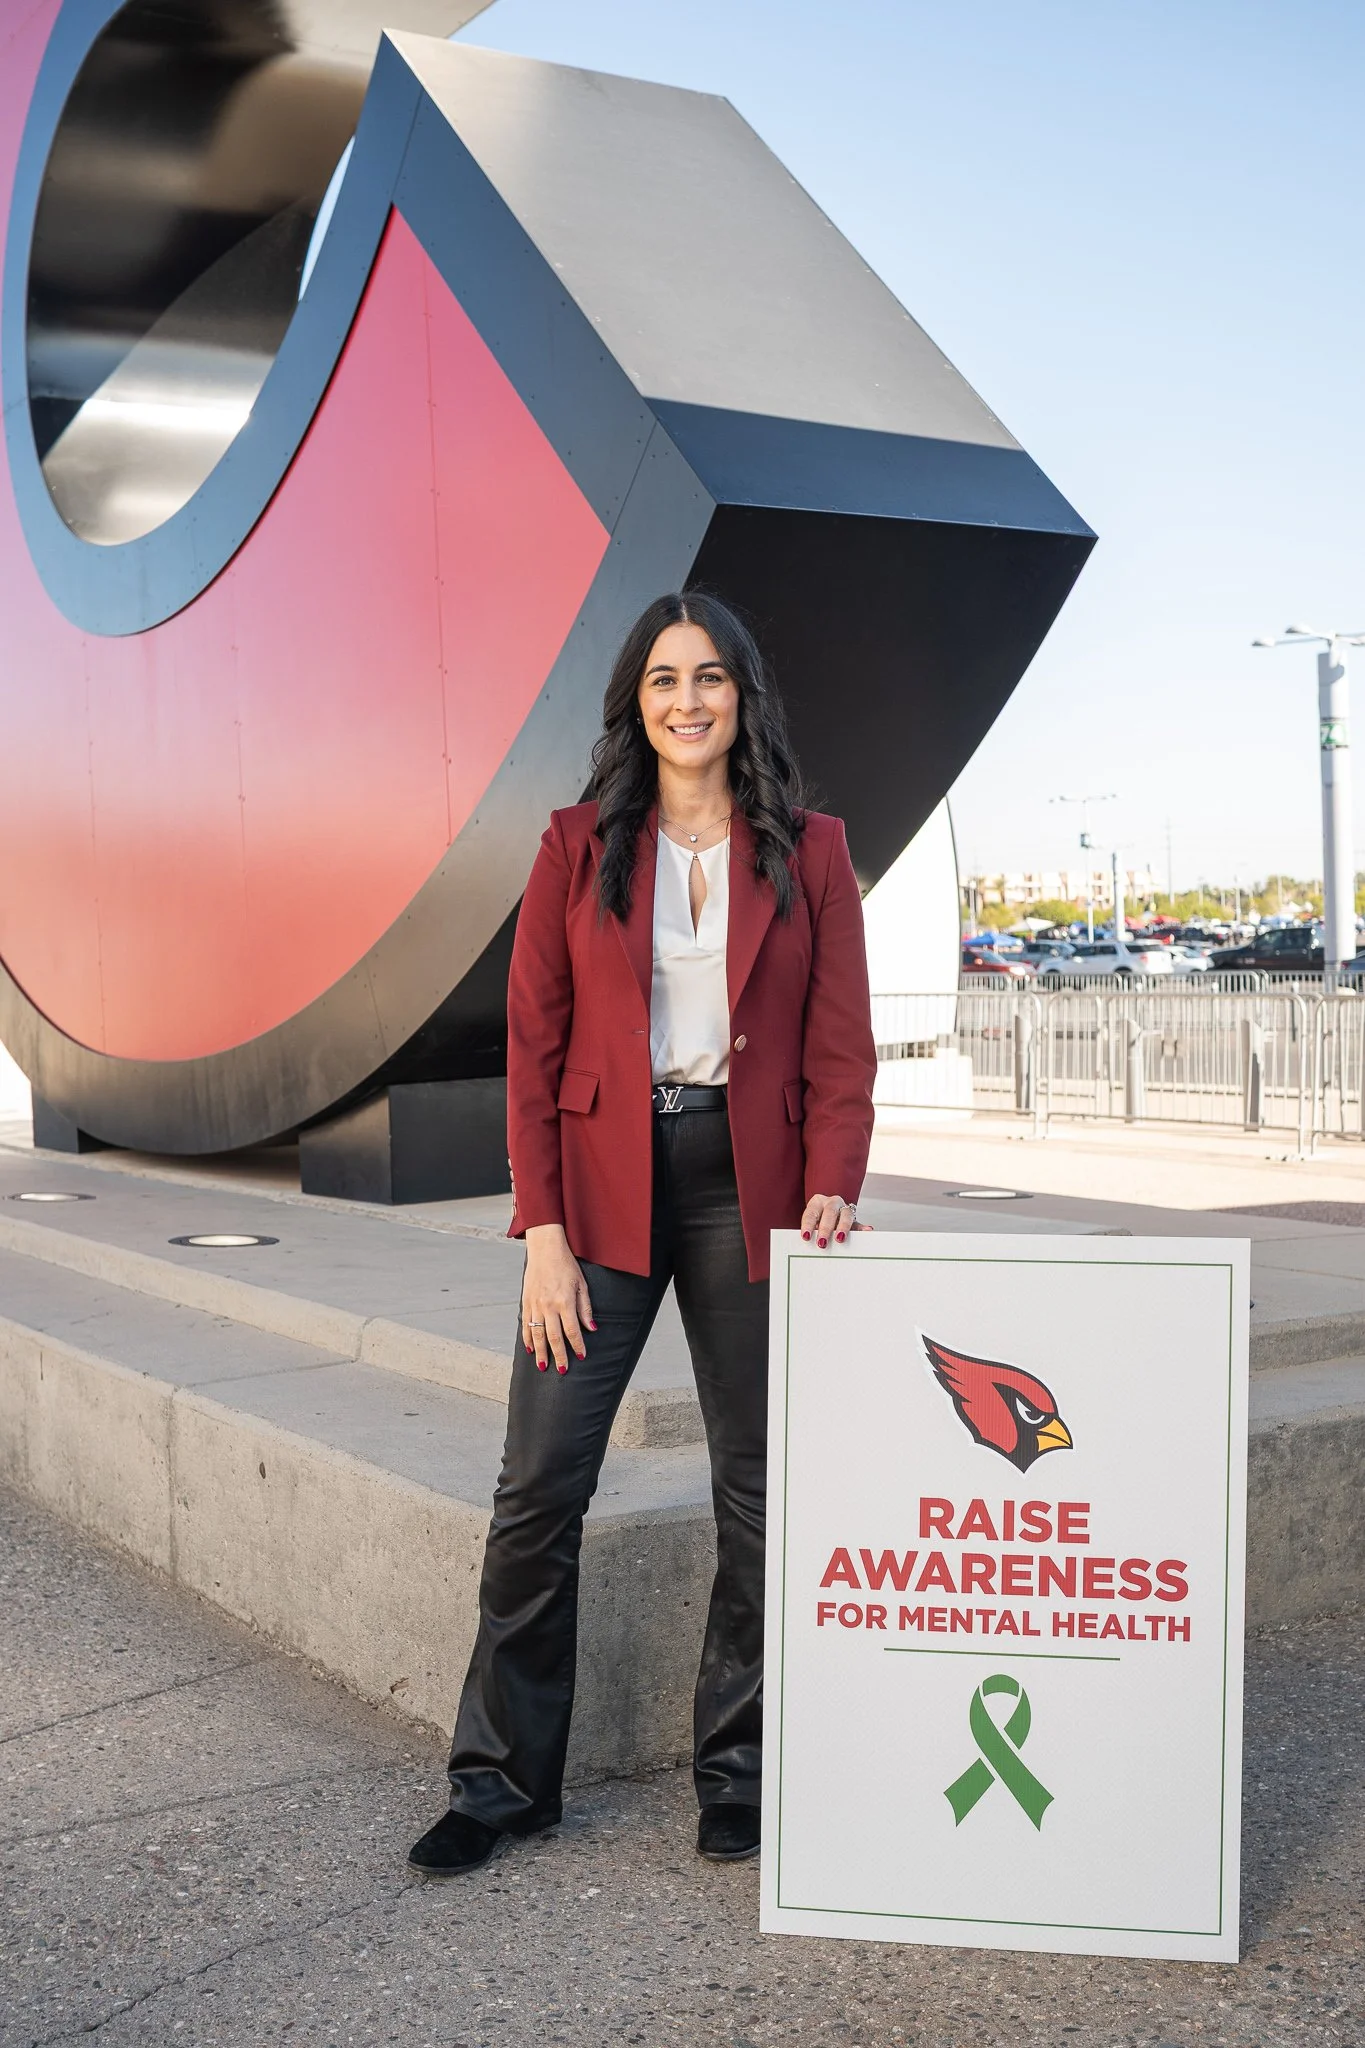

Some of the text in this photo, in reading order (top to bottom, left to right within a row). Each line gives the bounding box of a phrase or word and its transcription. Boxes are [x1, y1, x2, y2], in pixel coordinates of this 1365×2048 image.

[657, 1086, 684, 1114] LV
[919, 1497, 1090, 1544] RAISE
[819, 1547, 1189, 1602] AWARENESS
[817, 1601, 1191, 1642] FOR MENTAL HEALTH
